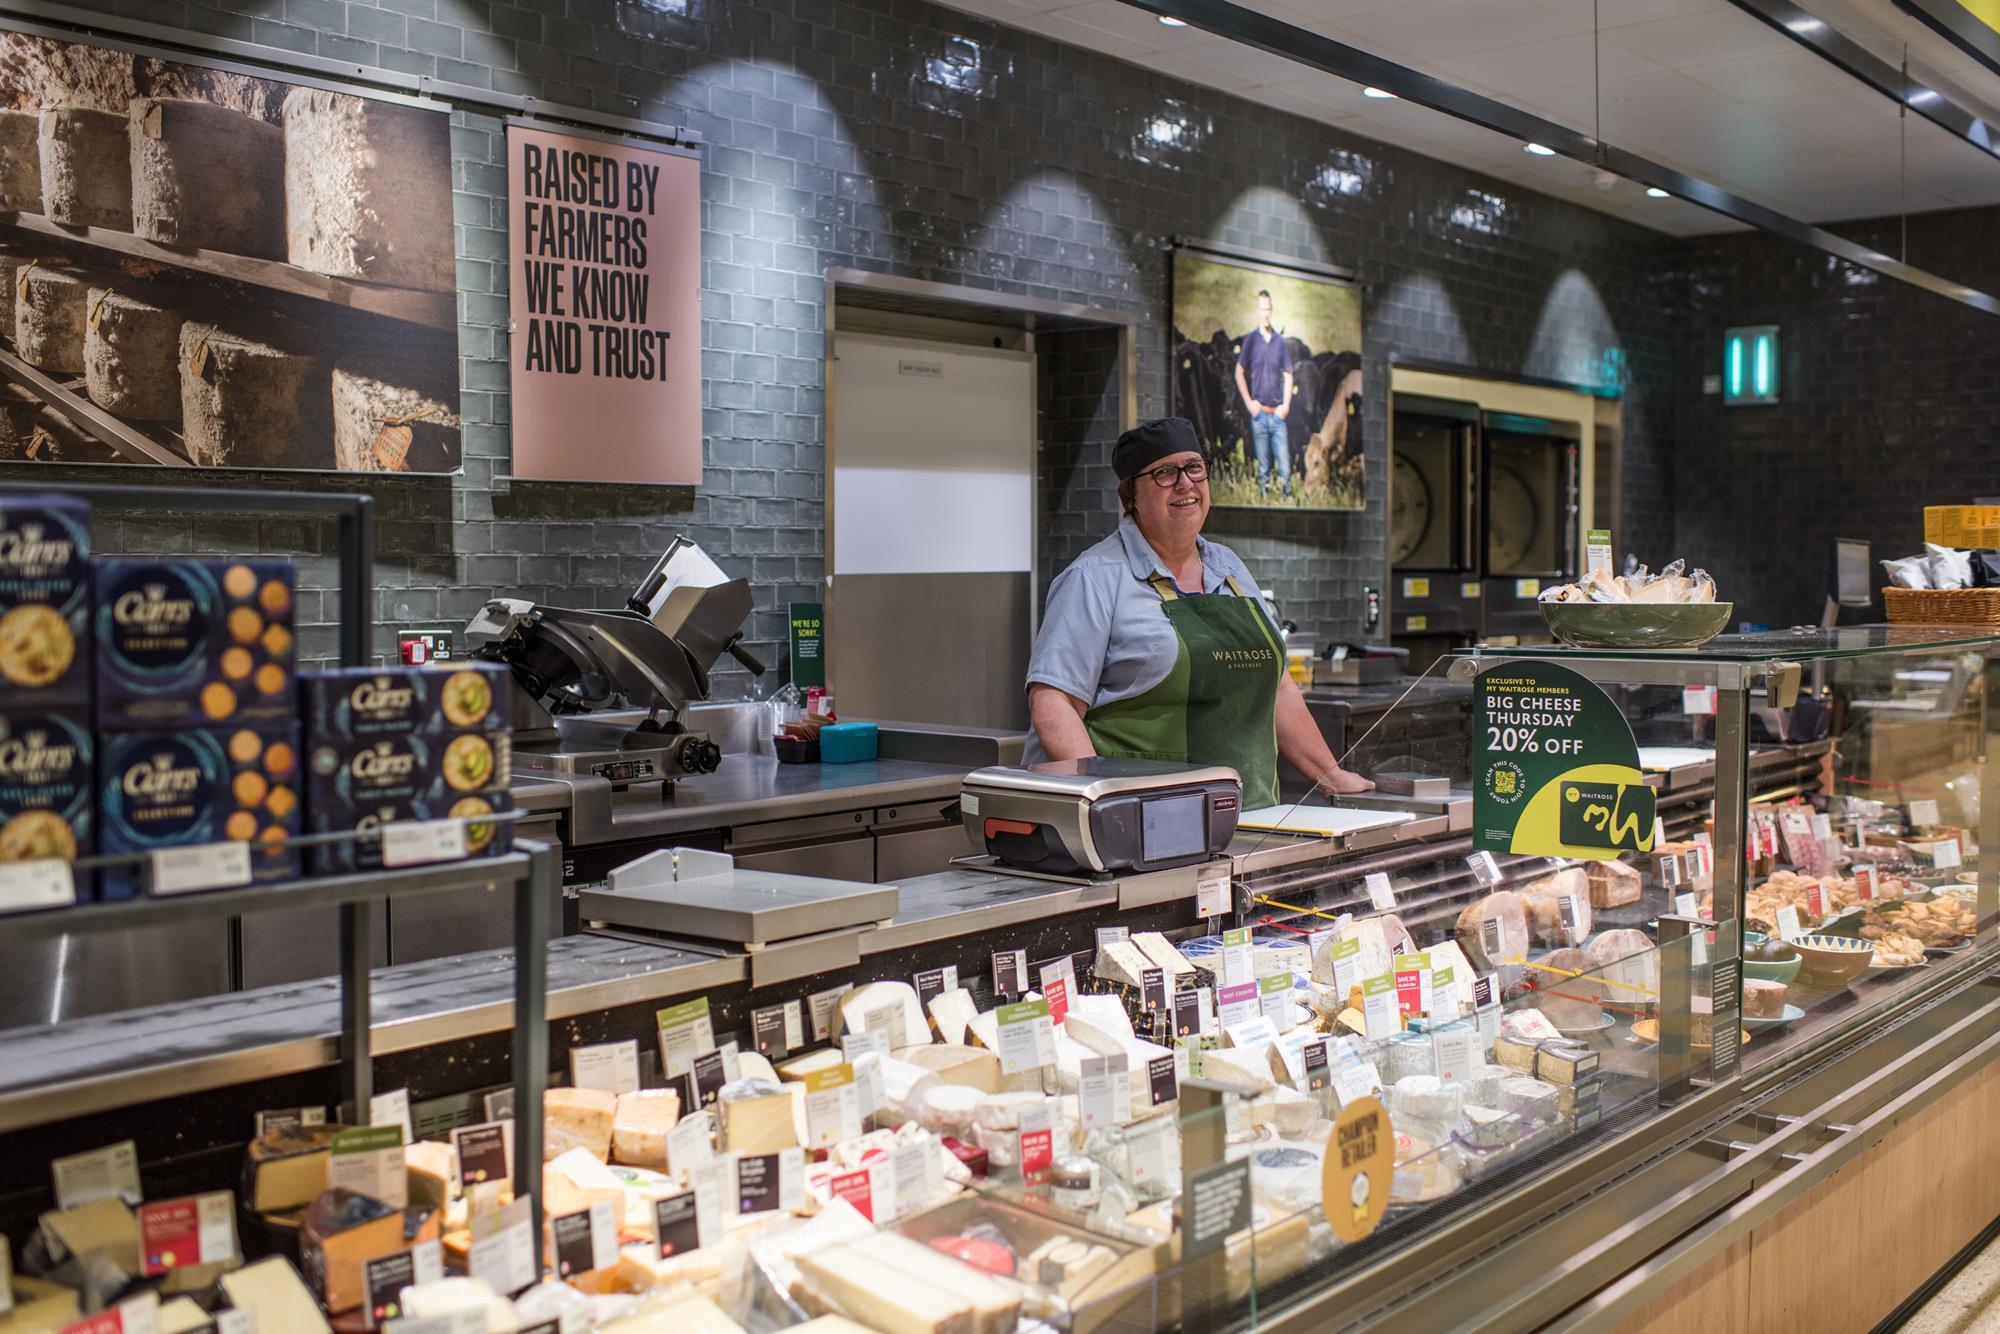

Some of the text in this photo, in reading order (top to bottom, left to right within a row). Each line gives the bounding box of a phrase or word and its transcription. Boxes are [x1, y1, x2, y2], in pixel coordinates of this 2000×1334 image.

[524, 143, 660, 215] RAISED BY
[524, 202, 647, 269] FARMERS
[524, 260, 649, 324] WE KNOW
[525, 318, 670, 381] AND TRUST
[1212, 650, 1272, 660] WAITROSE
[1487, 696, 1582, 712] BIG CHEESE
[1487, 712, 1575, 727] THURSDAY
[1487, 726, 1583, 755] 20% OFF
[1485, 760, 1525, 804] SCAN THIS CODE TO JOIN TODAY
[1223, 987, 1254, 1000] WEST COUNTRY
[1338, 1111, 1379, 1148] CHAMPION
[1342, 1134, 1376, 1169] RETAILER
